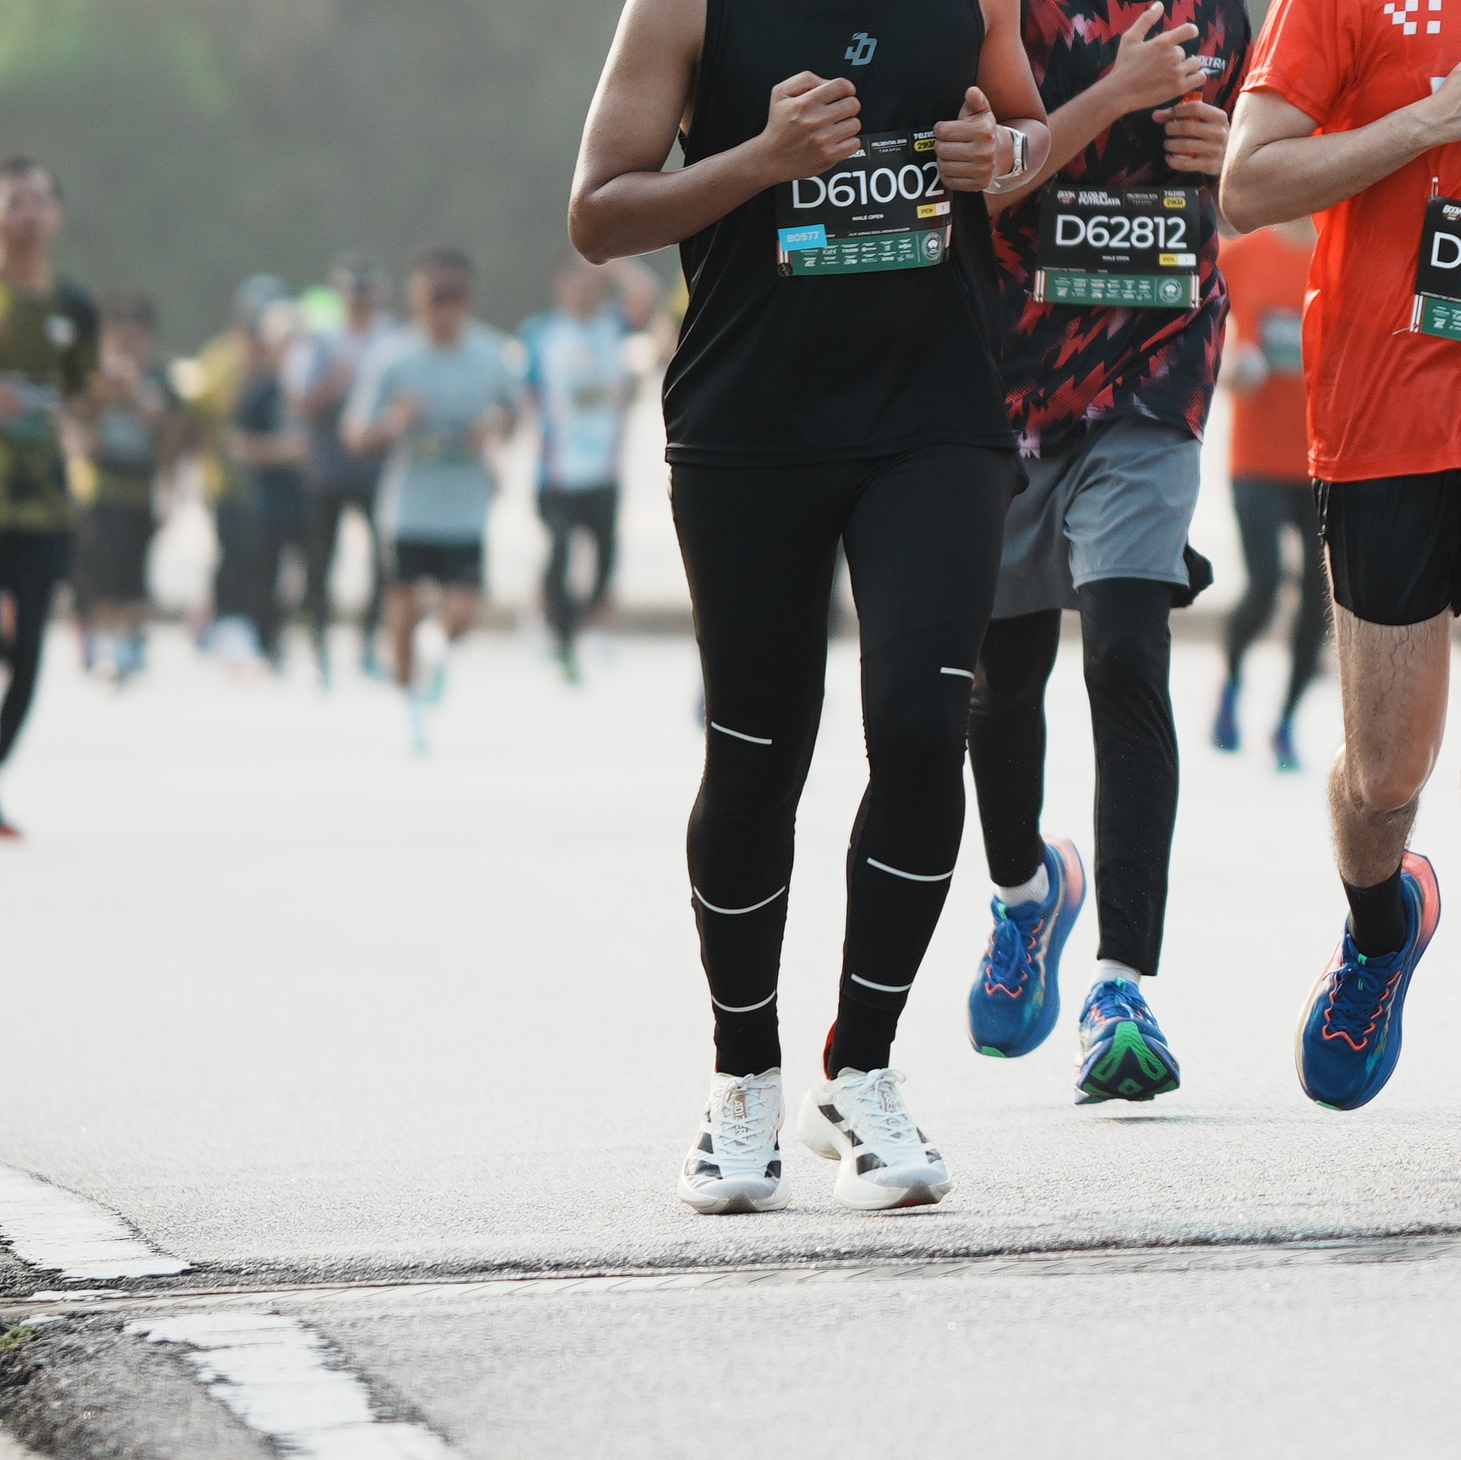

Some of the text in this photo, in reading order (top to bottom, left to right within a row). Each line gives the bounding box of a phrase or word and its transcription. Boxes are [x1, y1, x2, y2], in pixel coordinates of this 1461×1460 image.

[792, 162, 944, 208] D61002
[1078, 197, 1121, 206] PUTRAJAYA
[1055, 214, 1187, 249] D62812
